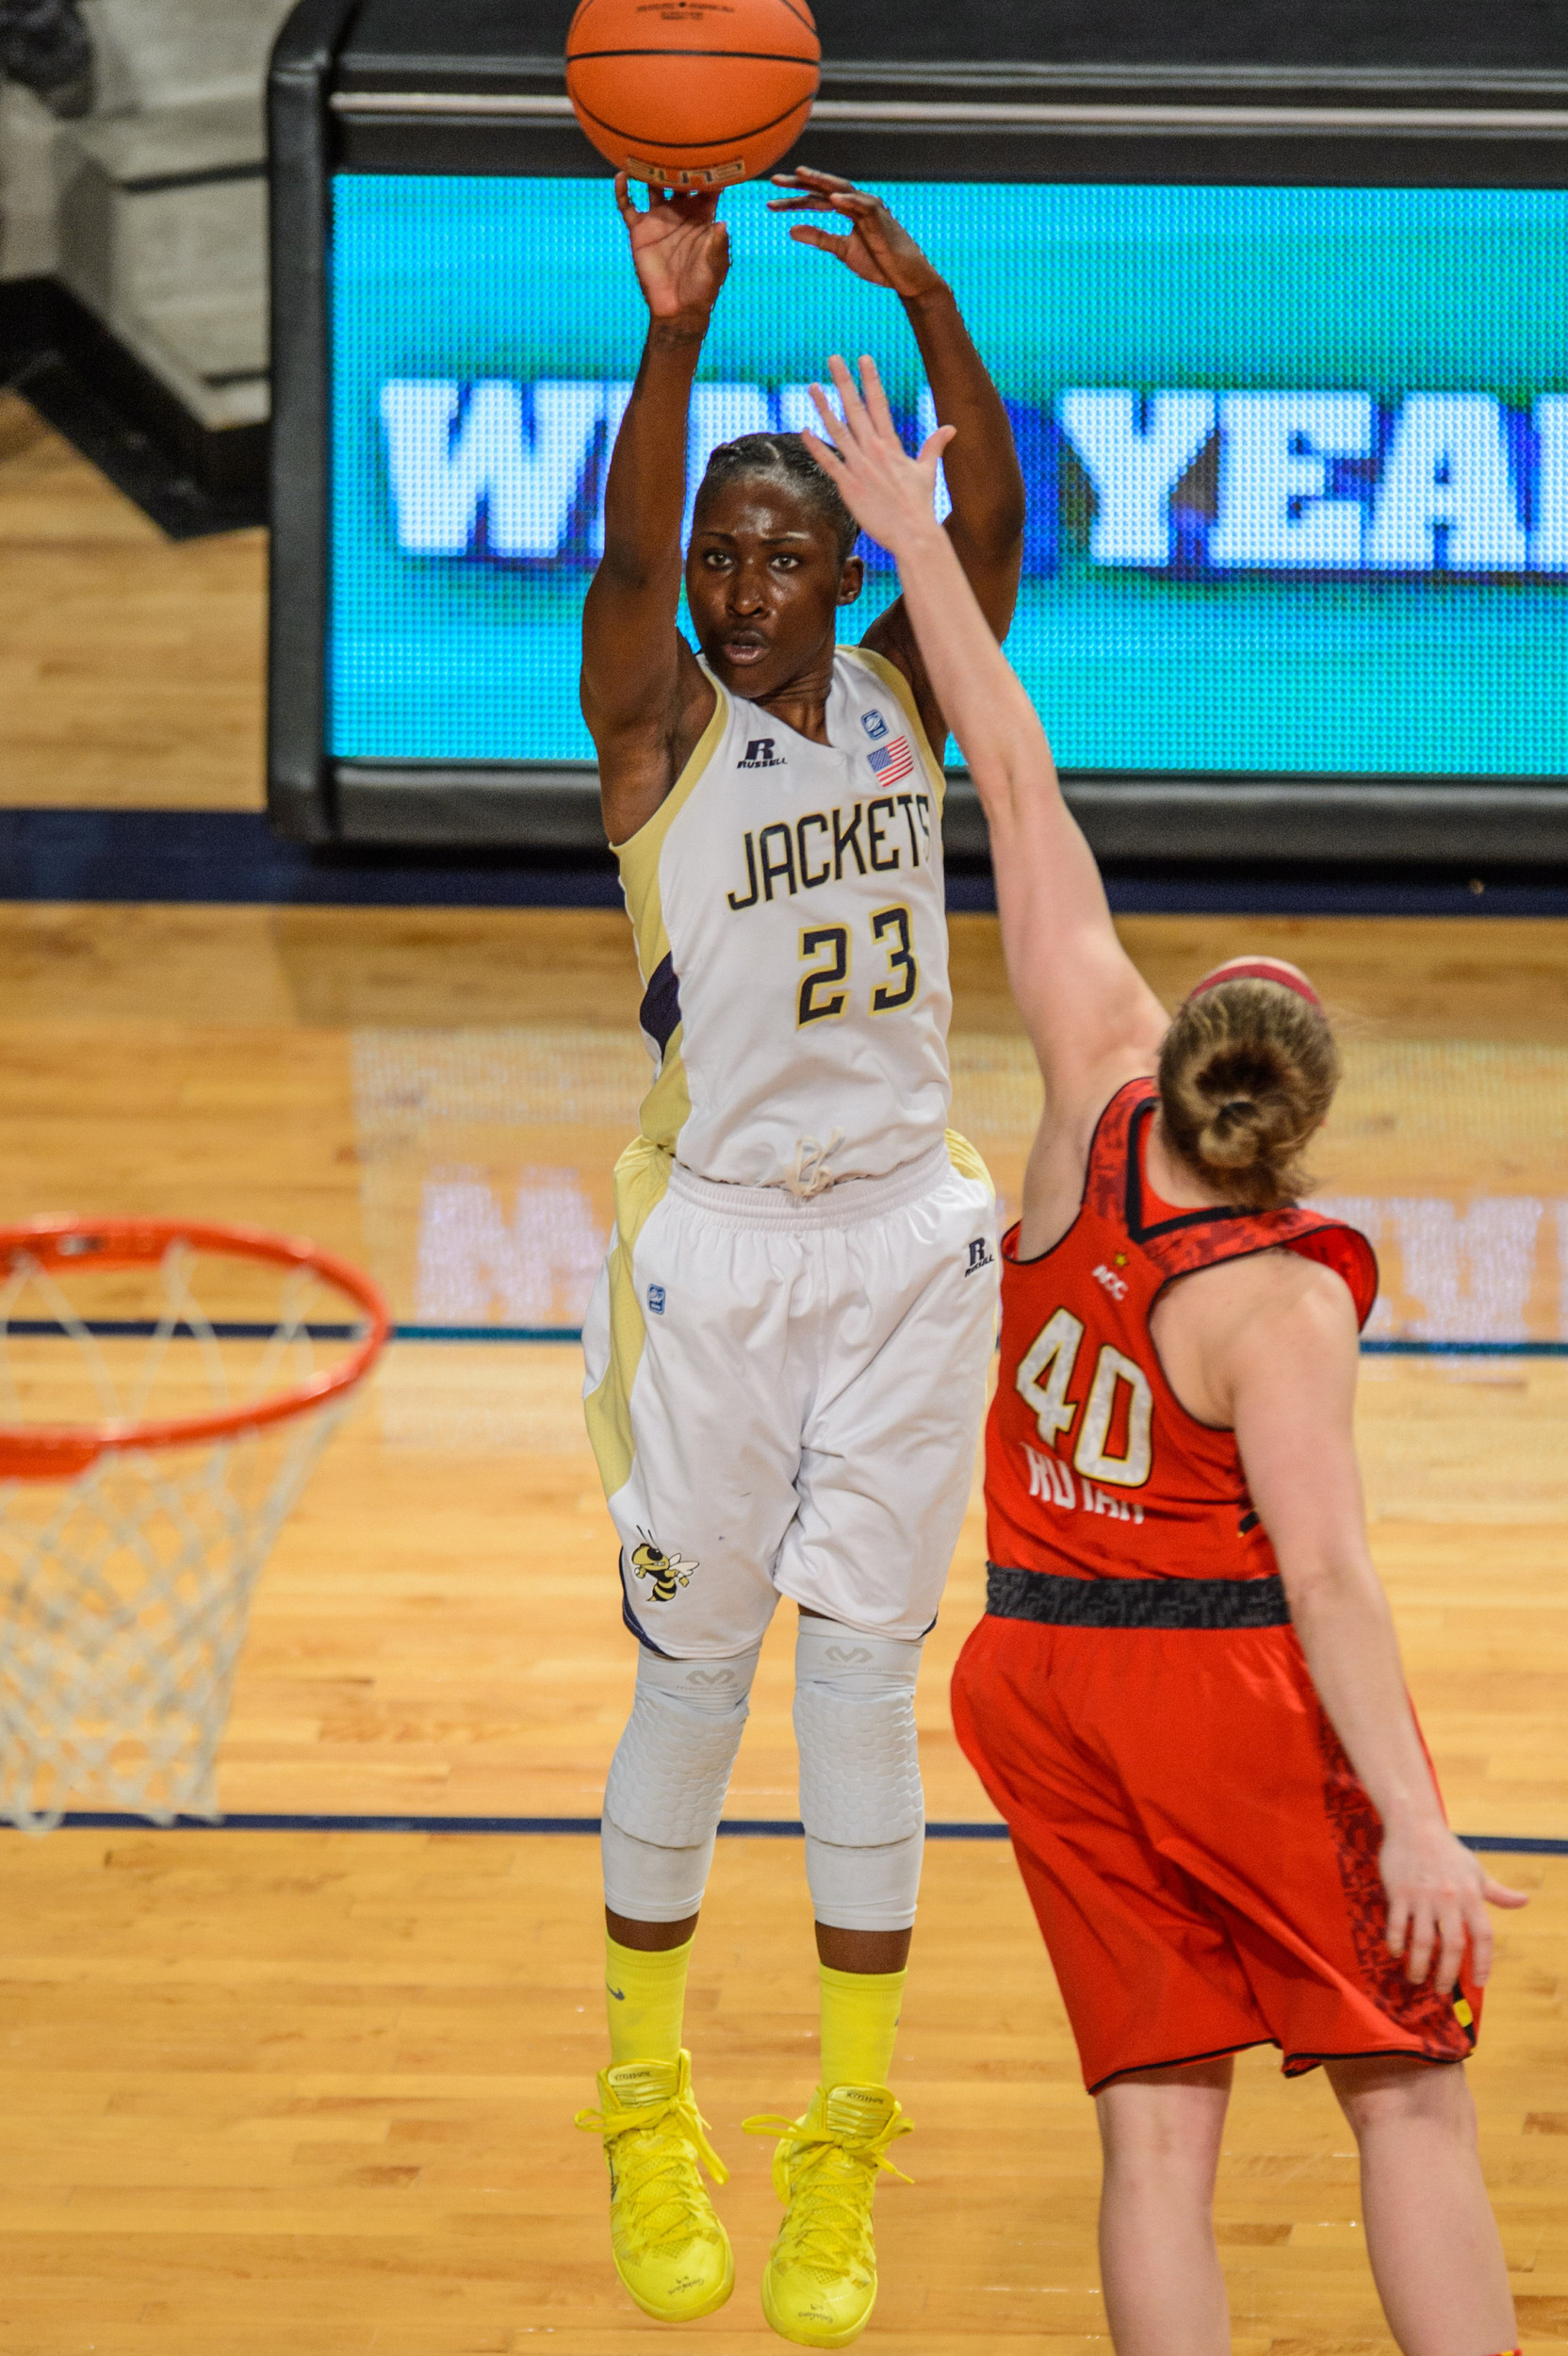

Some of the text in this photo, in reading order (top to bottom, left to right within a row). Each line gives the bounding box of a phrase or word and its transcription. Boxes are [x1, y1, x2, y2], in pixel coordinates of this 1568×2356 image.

[1062, 386, 1568, 571] YEA
[737, 758, 788, 769] RUSSELL
[745, 738, 776, 761] R
[795, 901, 922, 1030] 23
[1015, 1304, 1154, 1489] 40
